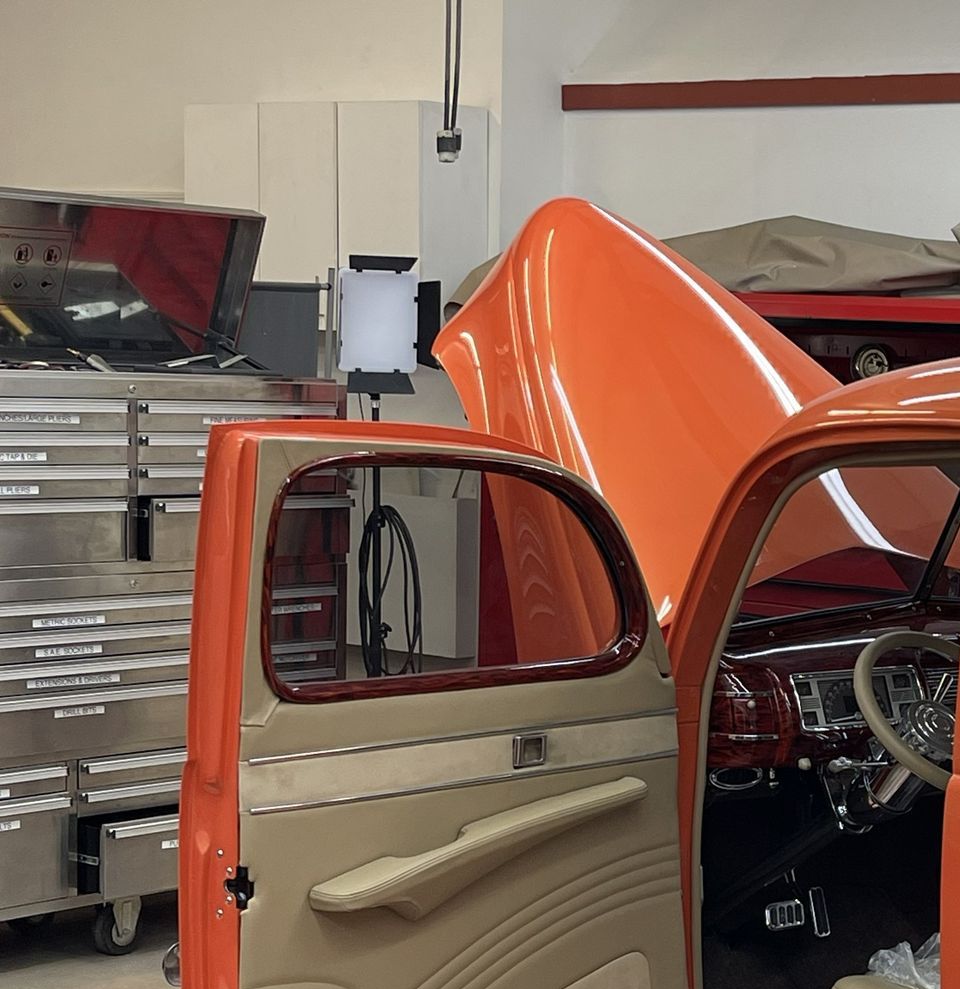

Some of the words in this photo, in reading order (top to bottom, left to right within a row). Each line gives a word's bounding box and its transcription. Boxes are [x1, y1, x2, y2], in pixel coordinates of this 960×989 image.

[41, 617, 65, 626] METRIC
[67, 615, 98, 624] SOCKETS
[63, 645, 94, 654] SOCKETS
[35, 678, 76, 688] EXTENSIONS
[62, 708, 81, 717] DRILL
